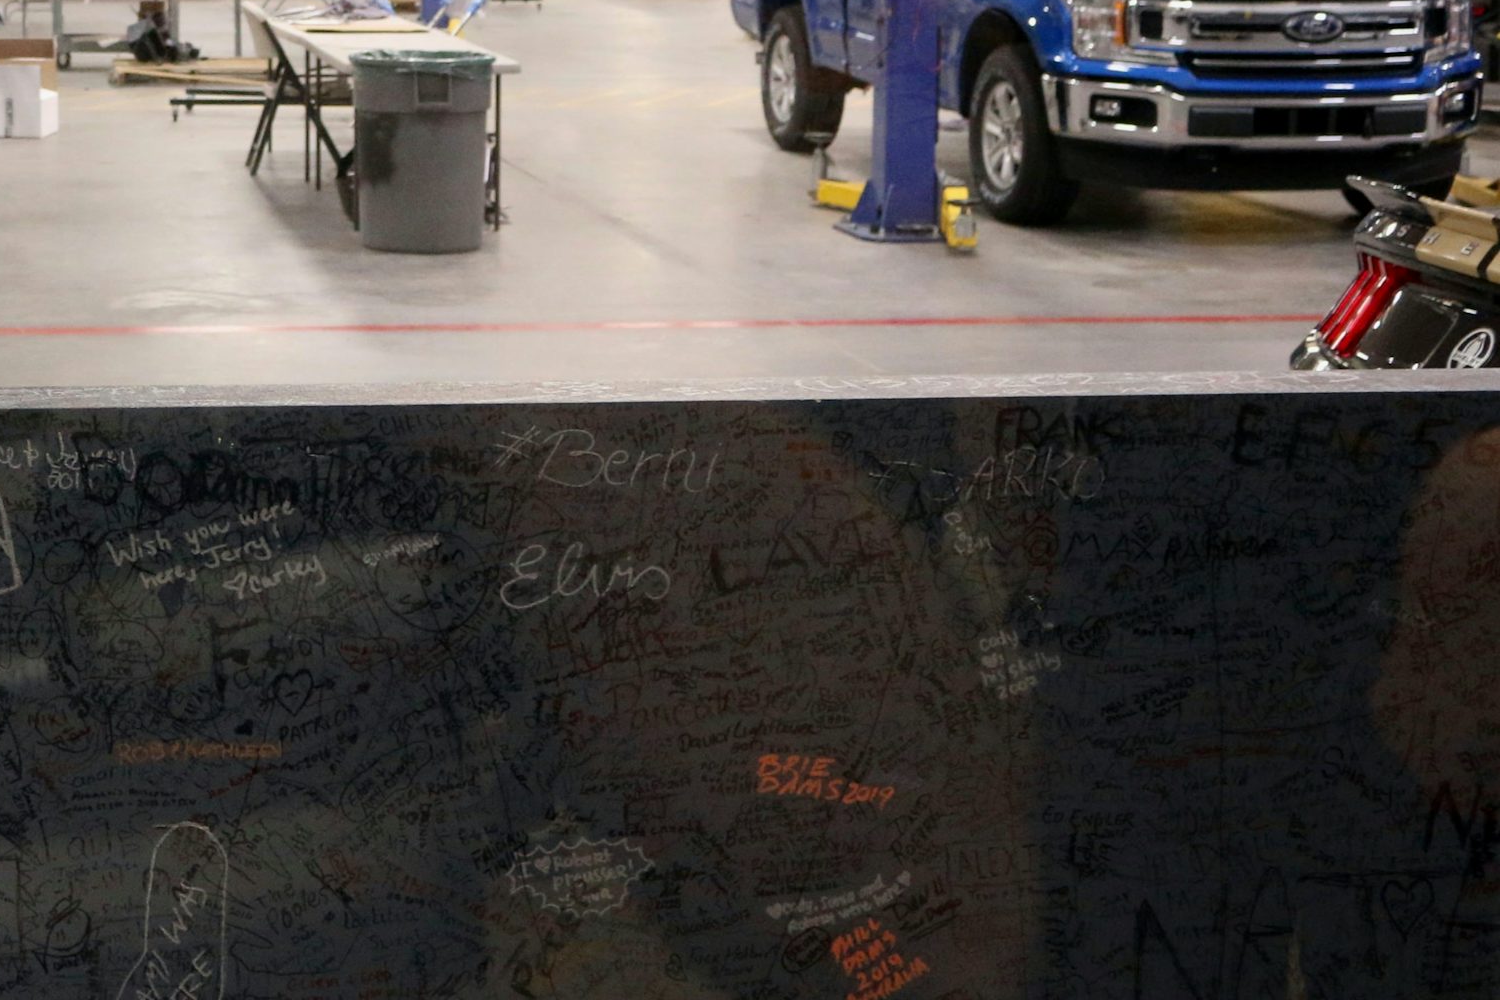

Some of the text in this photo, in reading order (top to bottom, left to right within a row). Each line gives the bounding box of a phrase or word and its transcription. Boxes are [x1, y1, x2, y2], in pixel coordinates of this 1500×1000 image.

[105, 500, 297, 567] Wish you were
[500, 541, 672, 610] Elvis
[756, 753, 836, 778] BRIE
[756, 776, 896, 811] DAMS 2019
